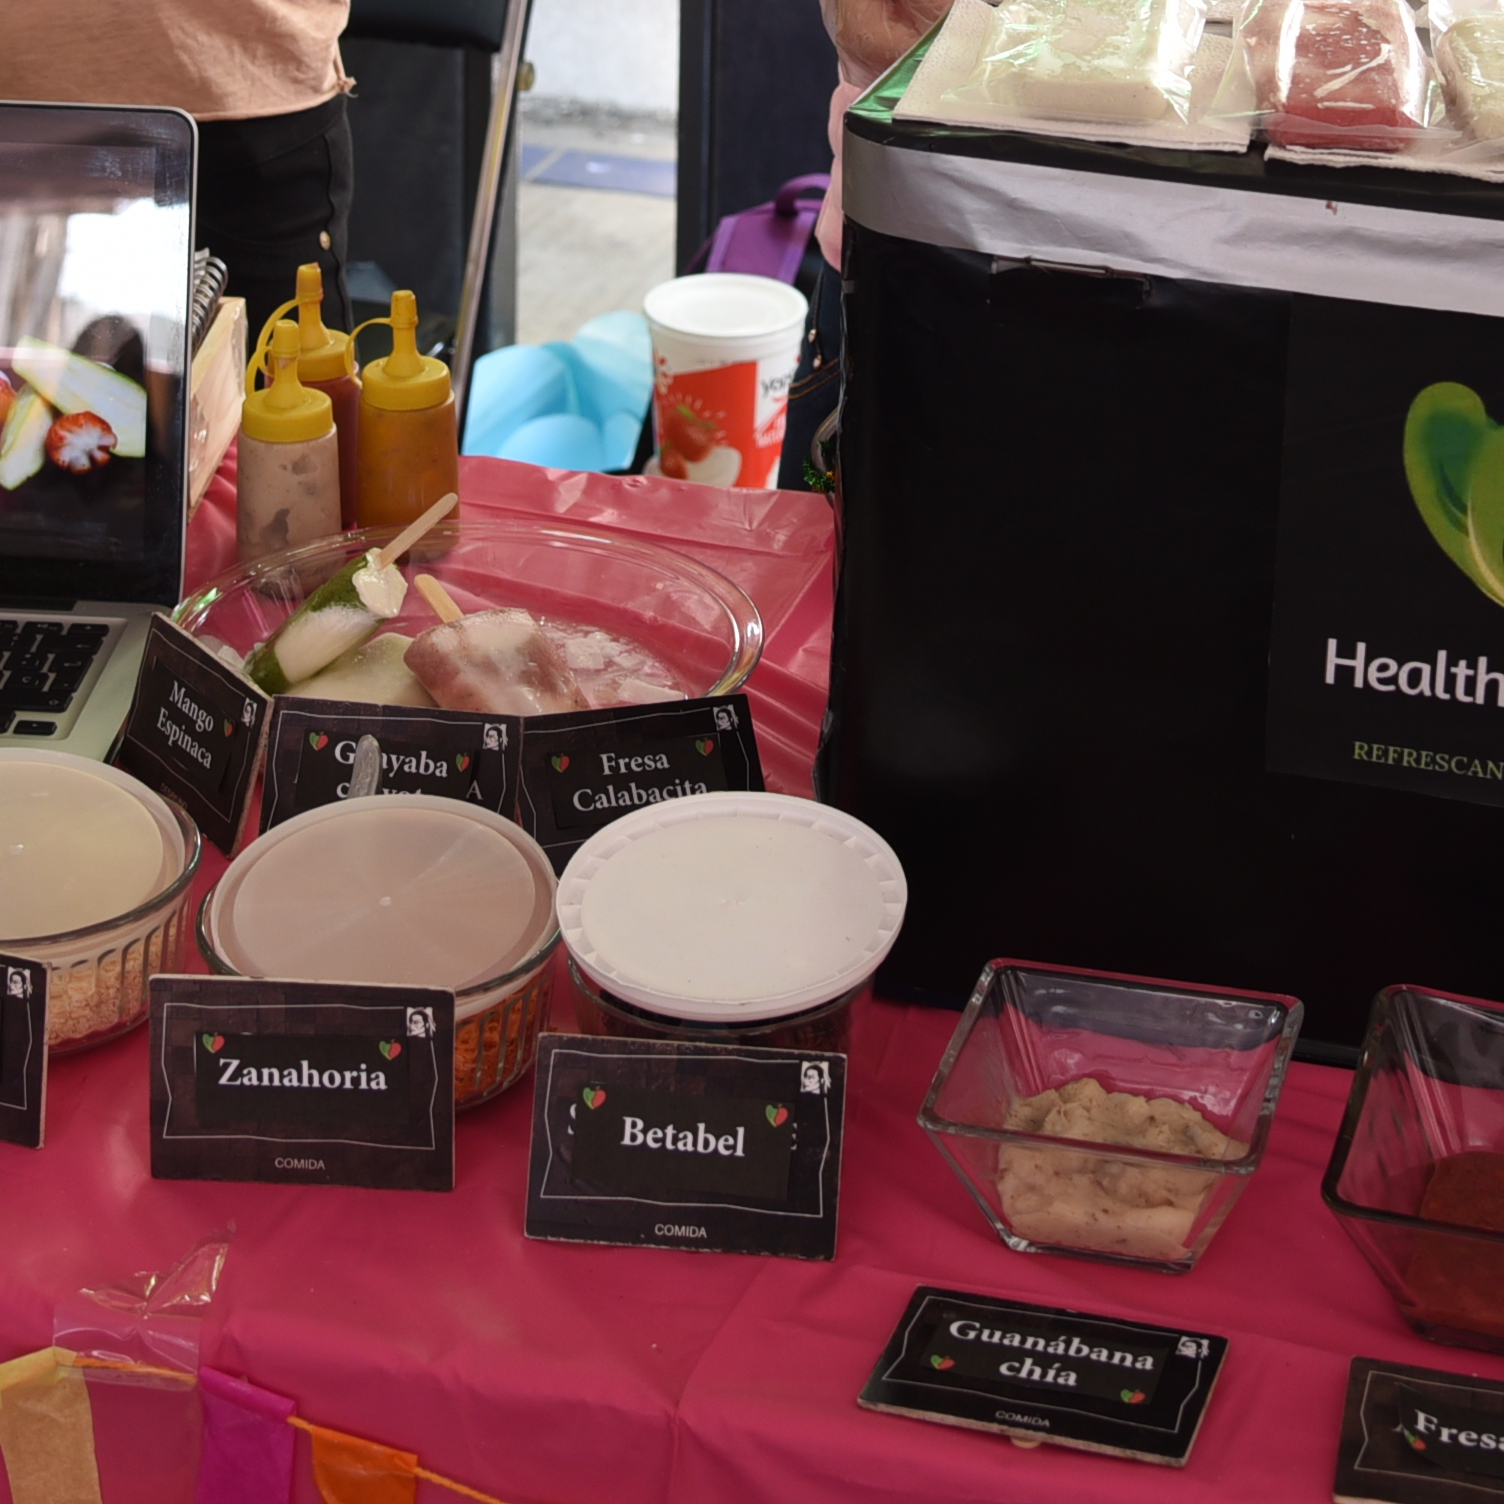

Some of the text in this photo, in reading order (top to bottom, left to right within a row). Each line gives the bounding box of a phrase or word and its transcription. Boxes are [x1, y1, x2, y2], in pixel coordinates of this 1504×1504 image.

[168, 679, 215, 733] Mango
[156, 706, 213, 770] Espinaca
[599, 752, 670, 776] Fresa
[572, 778, 709, 812] Calabacita
[218, 1058, 388, 1090] Zanahoria
[620, 1115, 746, 1158] Betabel
[274, 1157, 326, 1171] COMIDA
[654, 1223, 708, 1239] COMIDA
[949, 1319, 1155, 1371] Guanábana
[998, 1357, 1078, 1387] chía
[994, 1409, 1051, 1428] COMIDA
